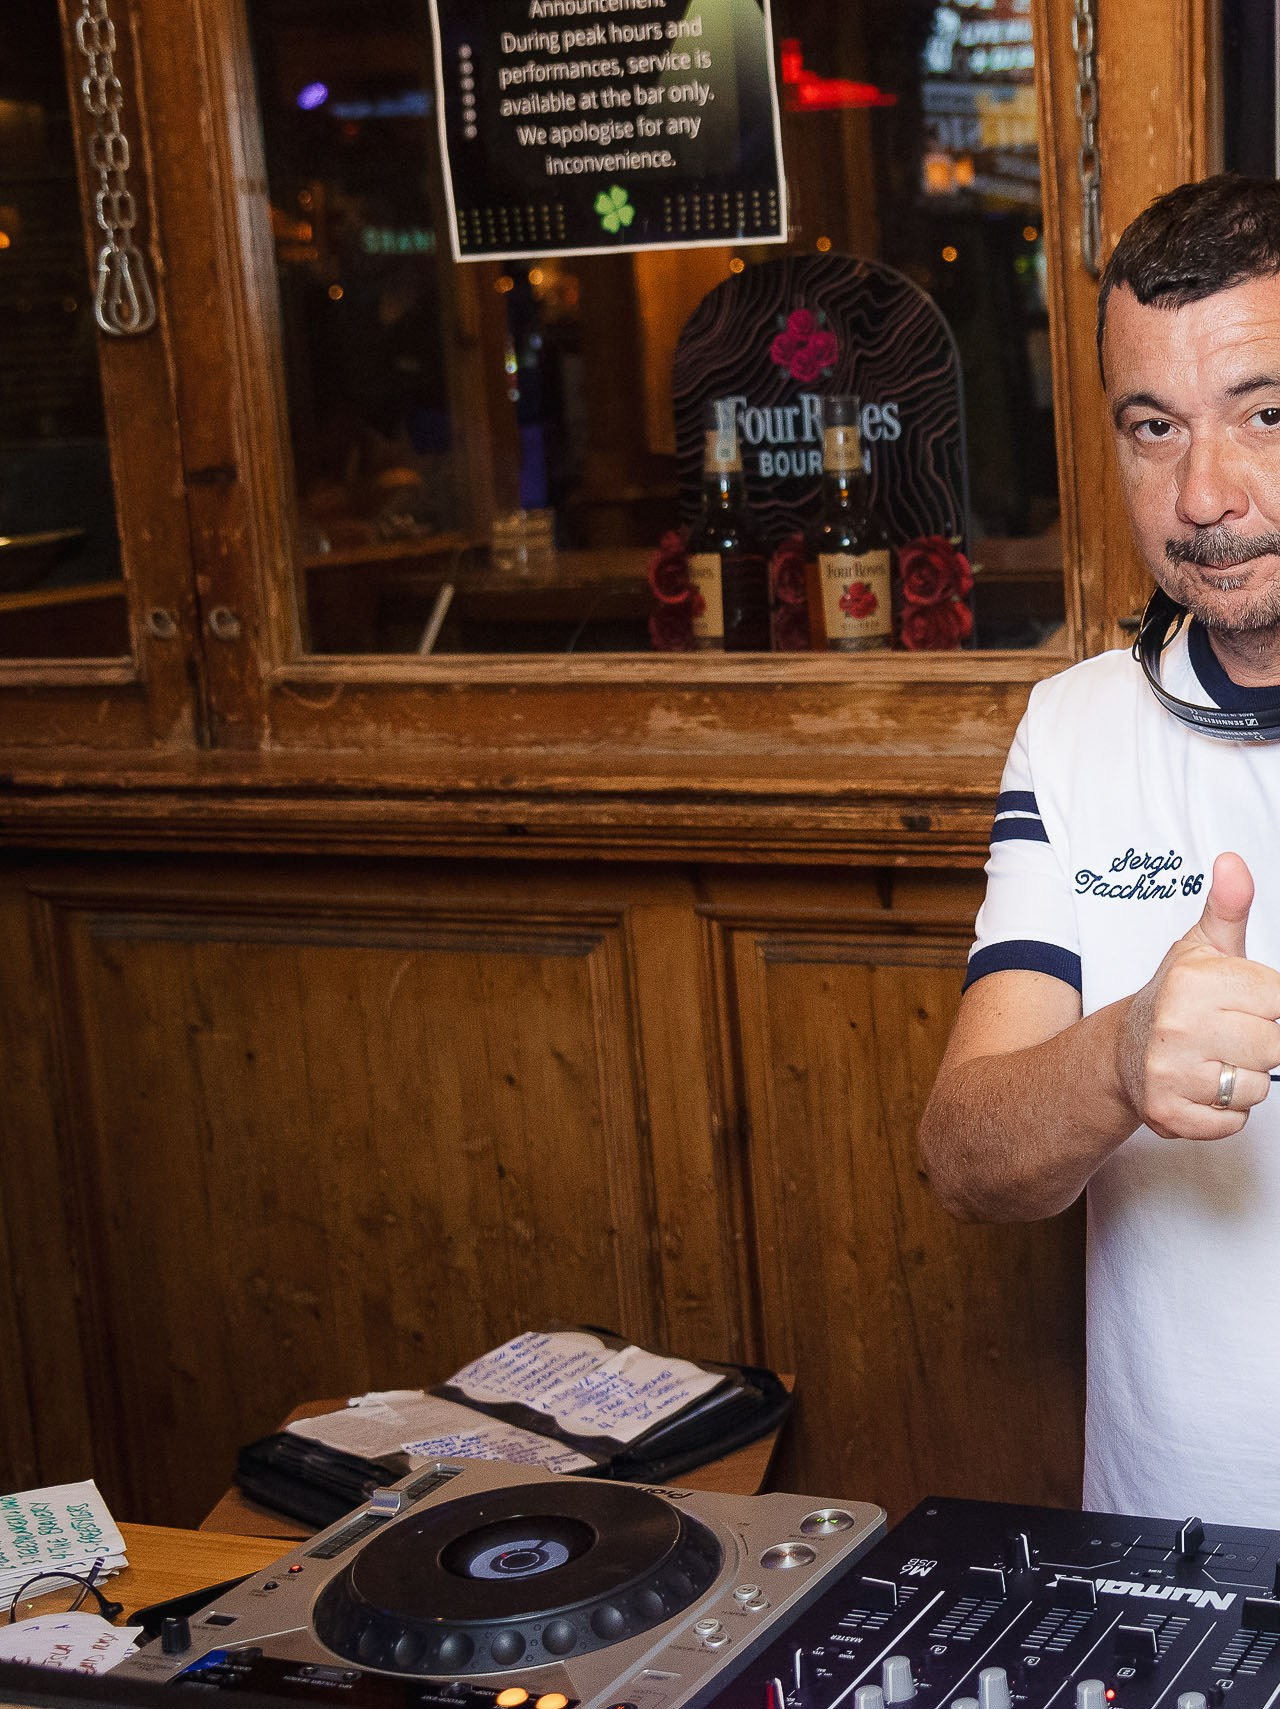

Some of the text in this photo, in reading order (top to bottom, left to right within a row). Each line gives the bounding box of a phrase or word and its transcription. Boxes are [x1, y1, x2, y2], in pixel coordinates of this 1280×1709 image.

[501, 16, 702, 54] During peak hours and
[499, 49, 712, 90] performances, service is
[500, 81, 715, 117] available at the bar only.
[517, 116, 701, 148] We apologise for any
[546, 149, 676, 176] inconvenience.
[713, 396, 799, 445] Four
[1192, 714, 1244, 727] SENNHEISER
[1109, 847, 1183, 878] Sergio
[1074, 868, 1177, 901] Tacchini
[28, 1502, 64, 1536] BRAVERY
[899, 1565, 933, 1577] M6
[907, 1557, 938, 1569] USB
[830, 1634, 864, 1644] MASTER
